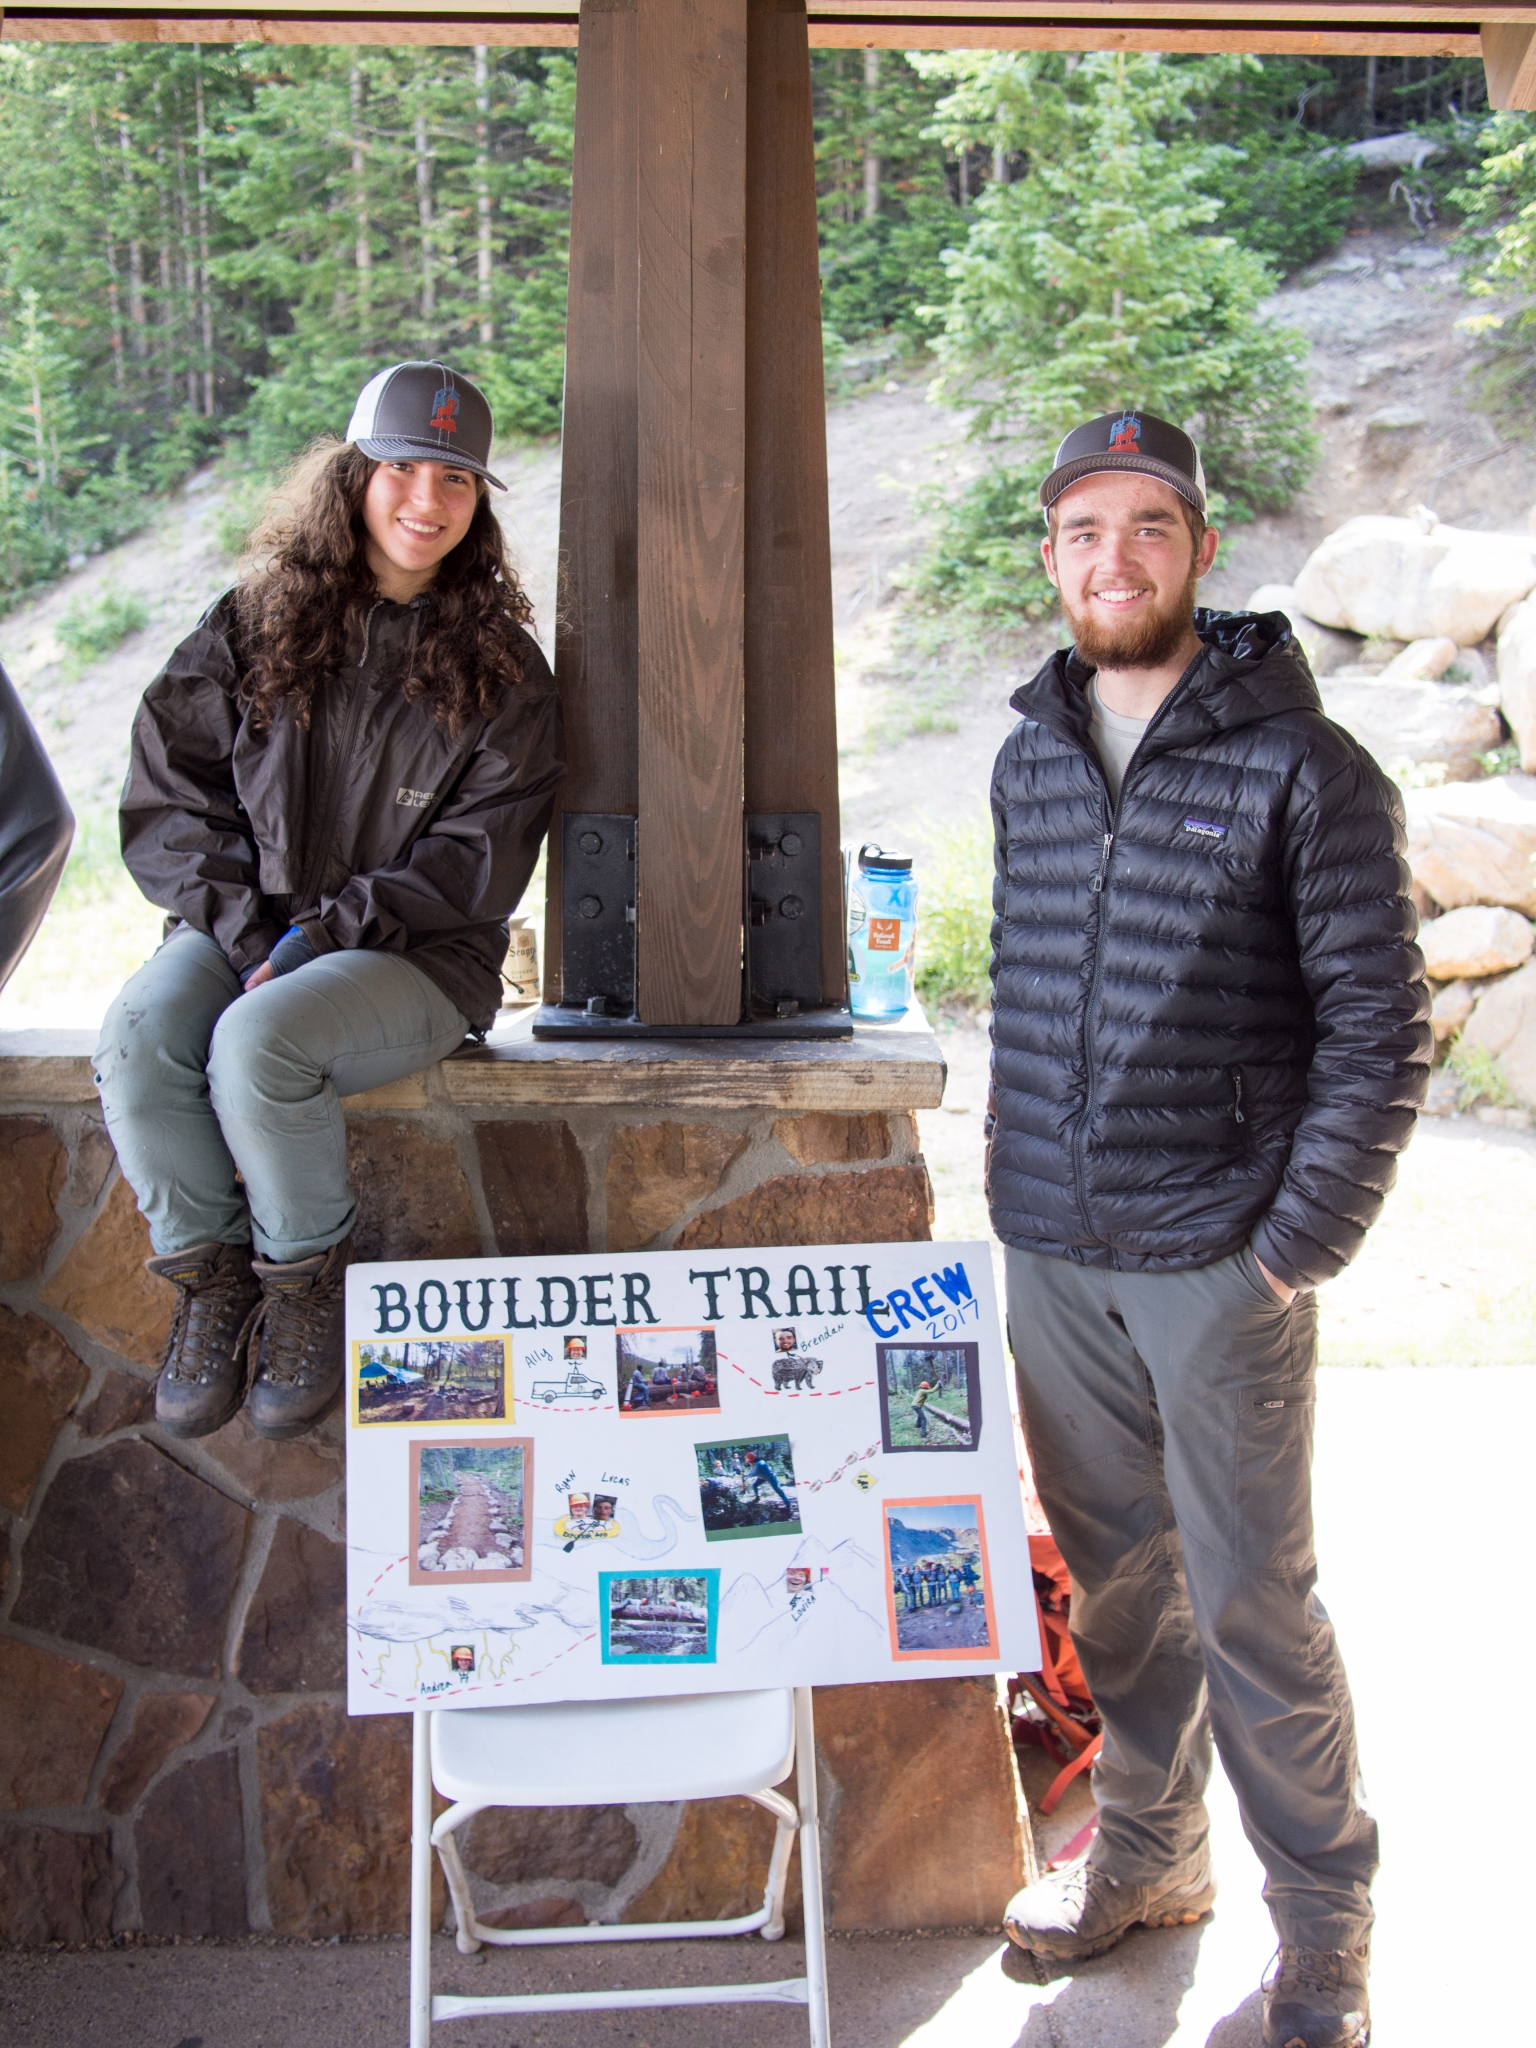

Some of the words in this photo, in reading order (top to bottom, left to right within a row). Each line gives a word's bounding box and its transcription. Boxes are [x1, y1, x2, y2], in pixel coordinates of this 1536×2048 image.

[1185, 826, 1221, 838] patagonia
[370, 1272, 662, 1334] BOULDER
[689, 1264, 890, 1321] TRAIL
[866, 1262, 973, 1339] CREW
[925, 1298, 979, 1340] 2017
[524, 1347, 554, 1369] Ally
[420, 1680, 453, 1695] Andrea
